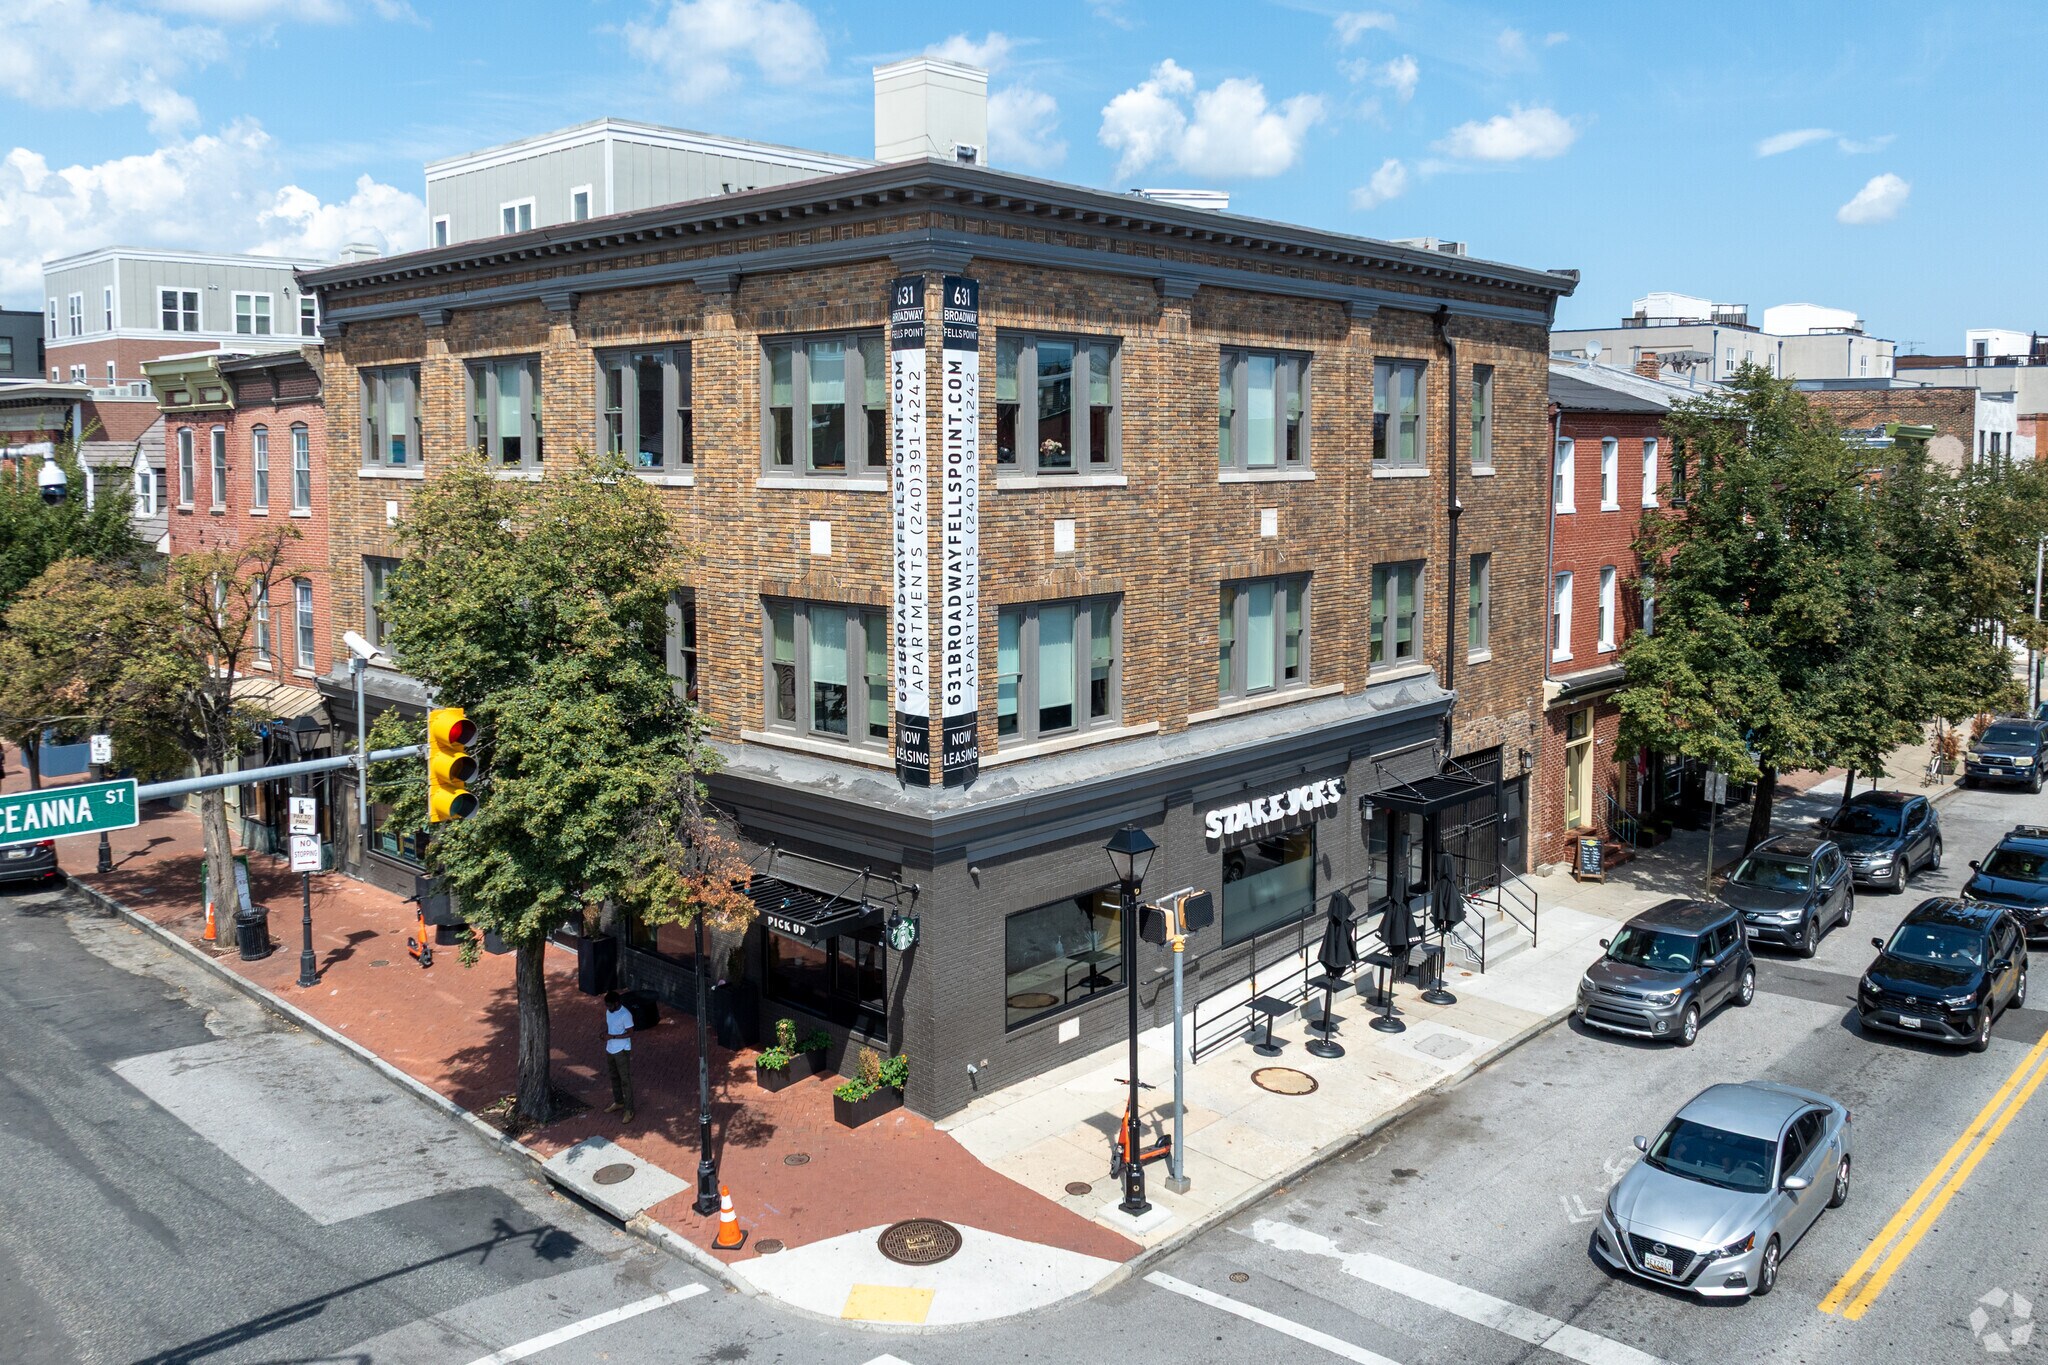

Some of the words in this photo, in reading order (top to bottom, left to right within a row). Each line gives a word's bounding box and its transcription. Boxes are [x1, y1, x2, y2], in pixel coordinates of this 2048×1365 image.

[897, 286, 914, 305] 631
[954, 286, 971, 306] 631
[892, 309, 923, 323] BROADWAY
[944, 310, 977, 323] BROADWAY
[891, 329, 903, 339] FELLS
[904, 327, 923, 337] POINT
[944, 327, 962, 338] FELLS
[962, 330, 977, 340] POINT
[909, 371, 923, 535] (240)391-4242
[966, 373, 976, 534] (240)391-4242
[895, 361, 907, 702] 631BROADWAYFELLSPOINT.COM
[948, 361, 962, 706] 631BROADWAYFELLSPOINT.COM
[911, 547, 924, 691] APARTMENTS
[966, 546, 974, 687] APARTMENTS
[901, 730, 920, 745] NOW
[952, 729, 971, 746] NOW
[896, 746, 929, 765] LEASING
[944, 746, 977, 766] LEASING
[105, 788, 126, 804] ST
[300, 839, 312, 847] NO
[294, 850, 318, 858] STOPPING
[767, 916, 791, 931] PICK
[793, 923, 806, 936] UP
